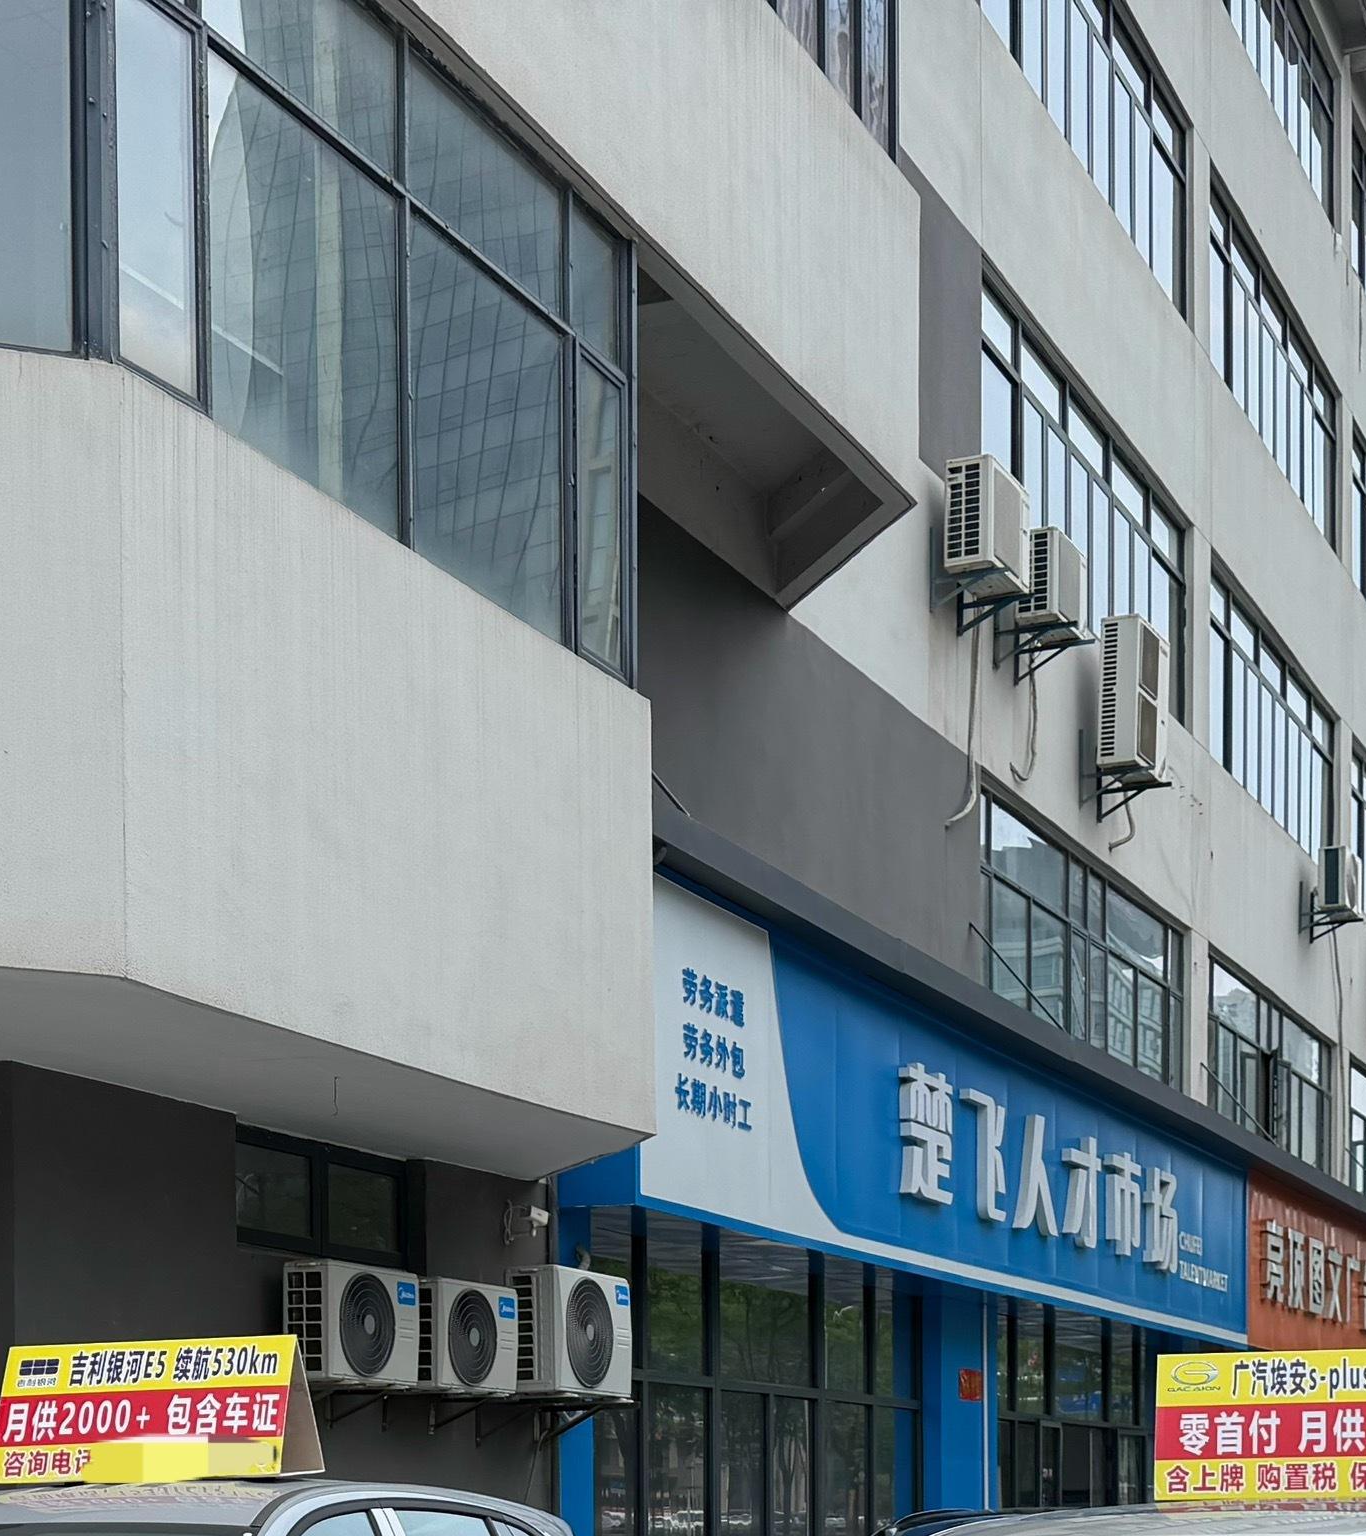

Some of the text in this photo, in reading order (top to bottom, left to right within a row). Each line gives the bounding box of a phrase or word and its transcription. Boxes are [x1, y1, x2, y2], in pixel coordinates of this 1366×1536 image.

[681, 967, 745, 1028] 劳务派遣
[682, 1022, 746, 1079] 劳务外包
[674, 1073, 753, 1131] 长期小时工
[897, 1062, 1178, 1274] 楚飞人才市场
[68, 1345, 279, 1387] 吉利银河E5 续航530km
[2, 1392, 281, 1443] 月供2000+ 包含车证
[1178, 1411, 1282, 1457] 零首付
[1166, 1463, 1245, 1494] 含上牌
[1257, 1462, 1337, 1492] 购置税
